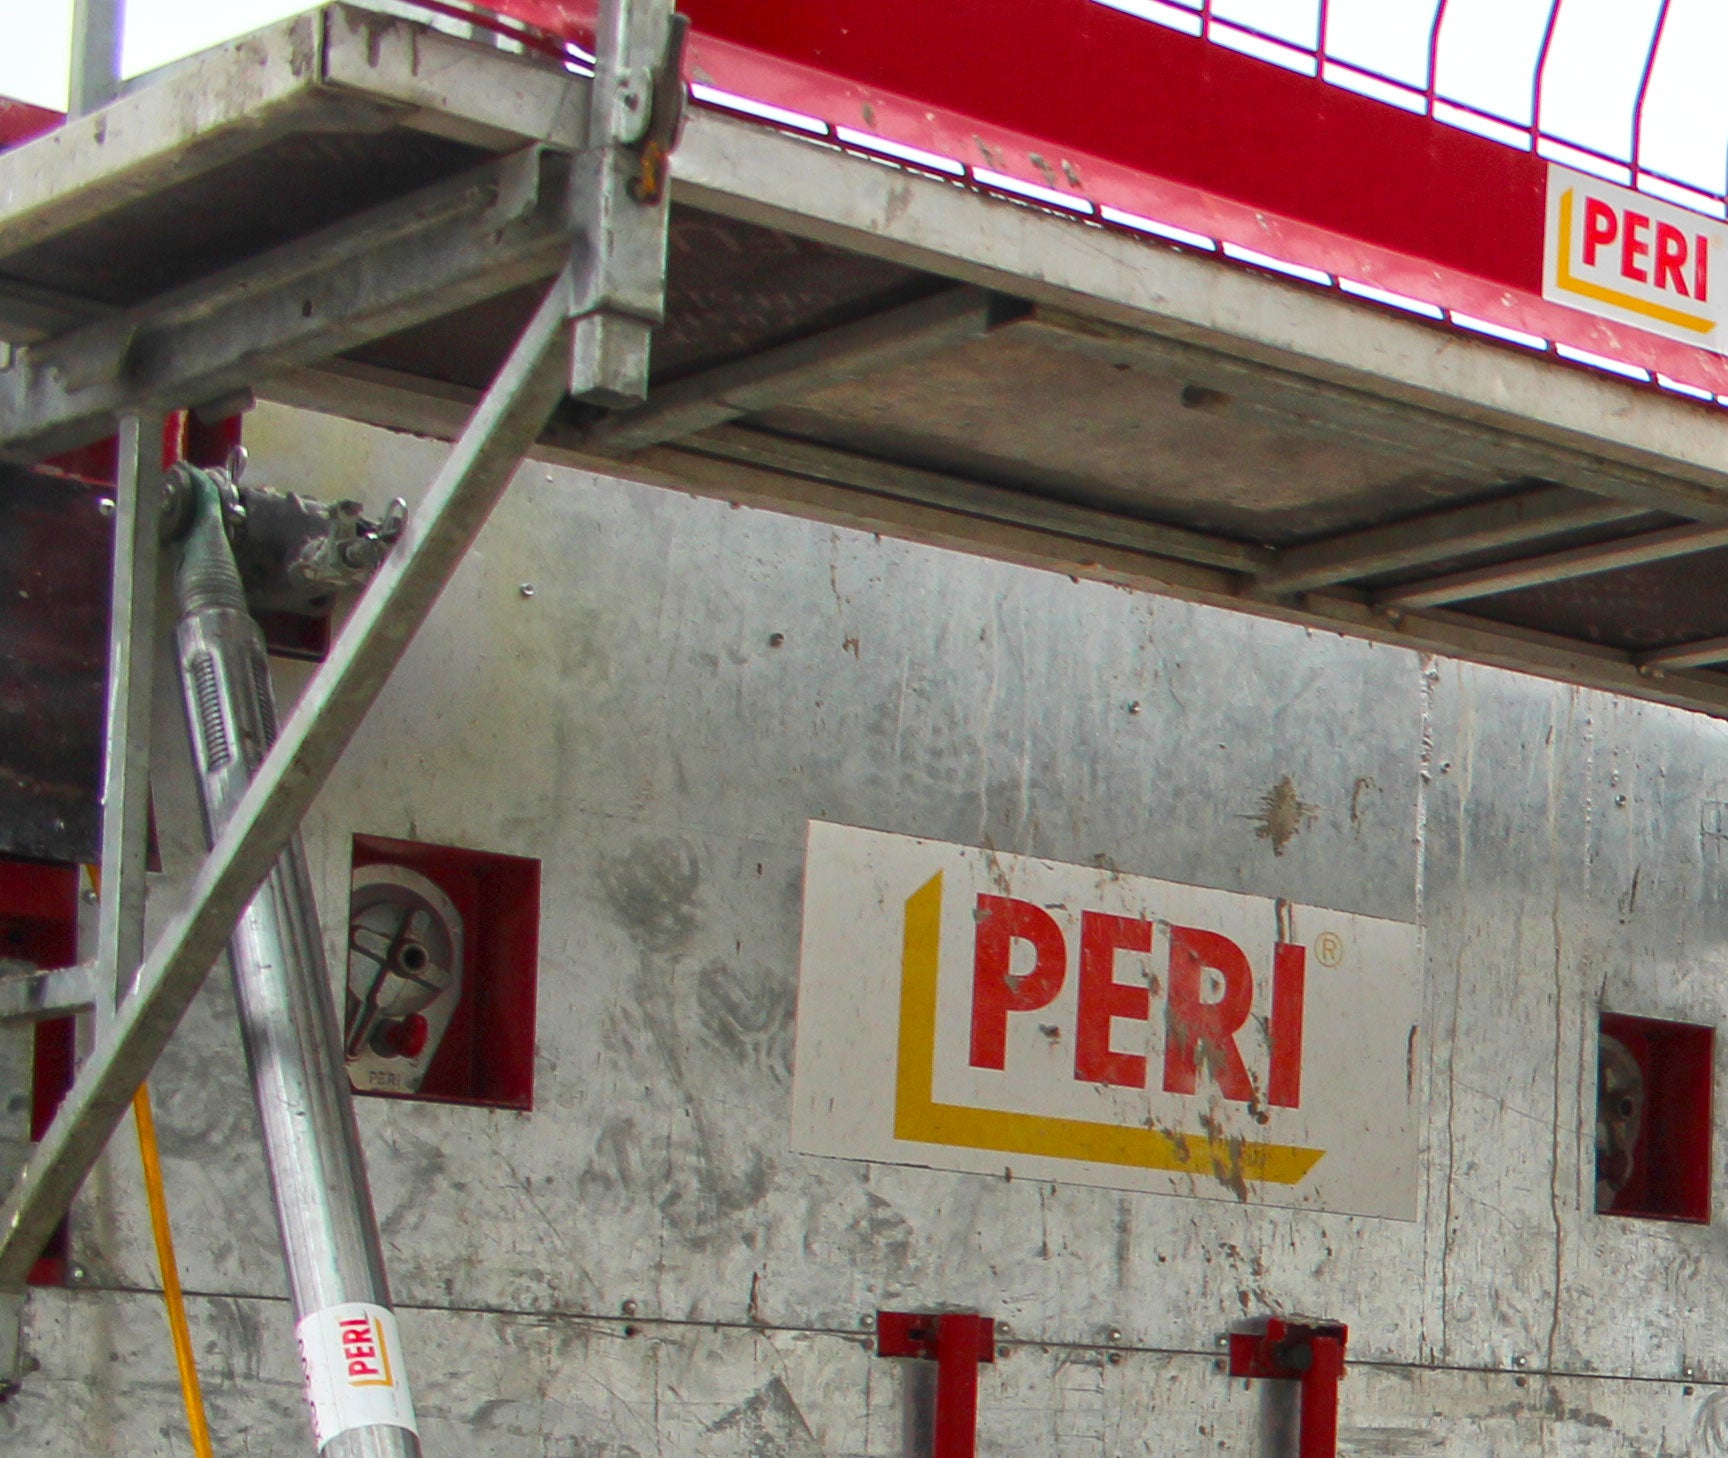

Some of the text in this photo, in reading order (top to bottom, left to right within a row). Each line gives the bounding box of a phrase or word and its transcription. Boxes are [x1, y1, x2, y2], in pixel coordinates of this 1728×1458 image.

[1582, 196, 1708, 302] PERI
[968, 892, 1307, 1109] PERI
[339, 1317, 380, 1377] PERI
